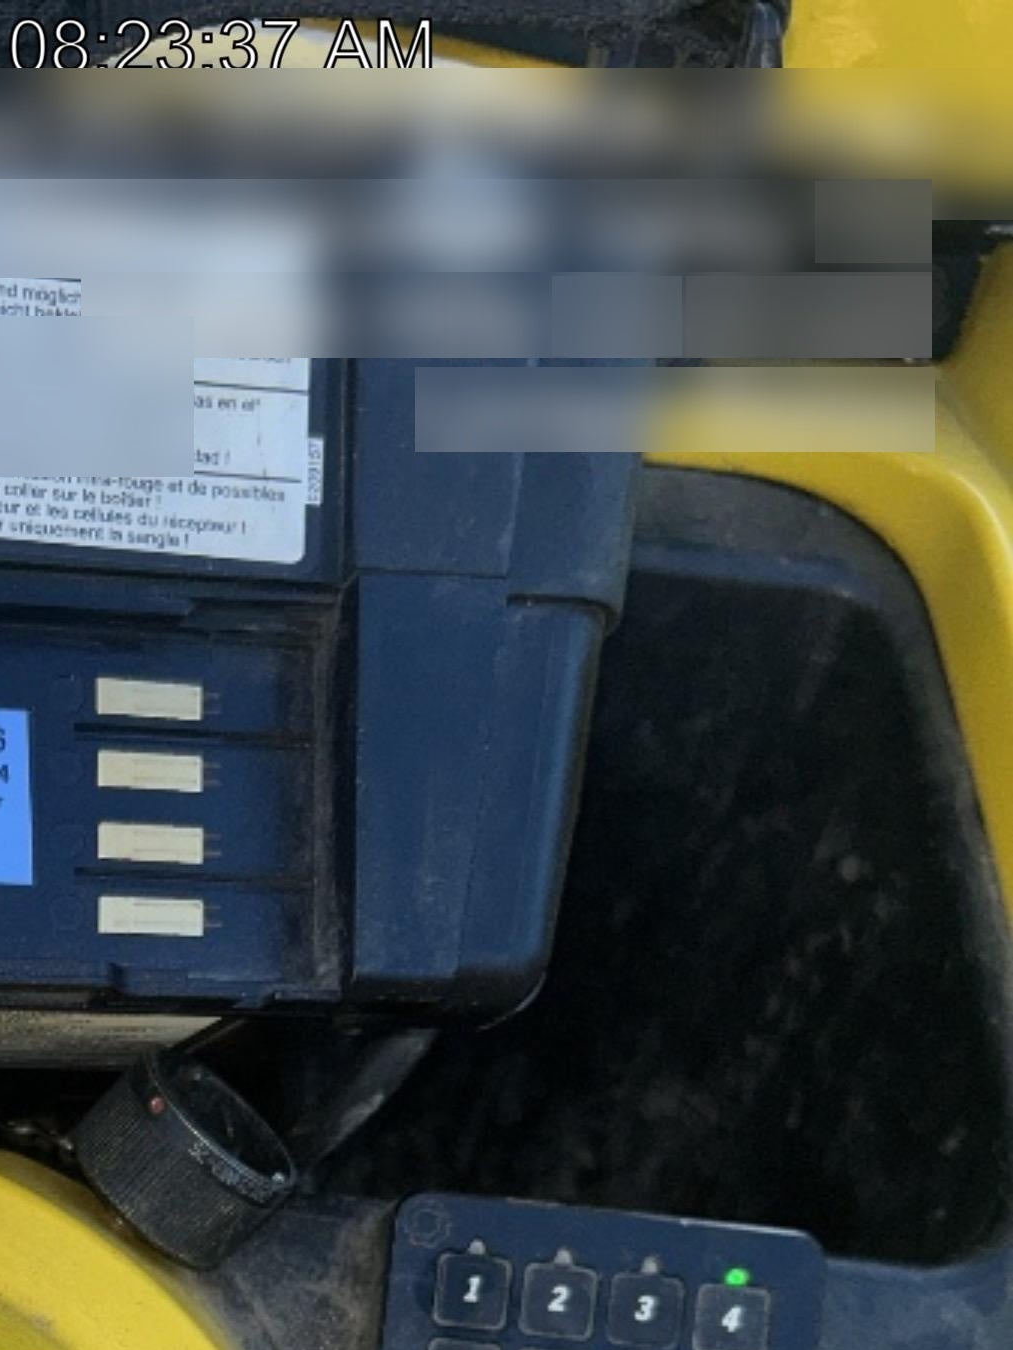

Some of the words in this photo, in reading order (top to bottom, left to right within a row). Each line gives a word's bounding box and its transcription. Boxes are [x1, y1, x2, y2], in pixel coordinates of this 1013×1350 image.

[462, 1276, 482, 1303] 1
[547, 1285, 571, 1312] 2
[634, 1296, 655, 1322] 3
[721, 1305, 741, 1333] 4
